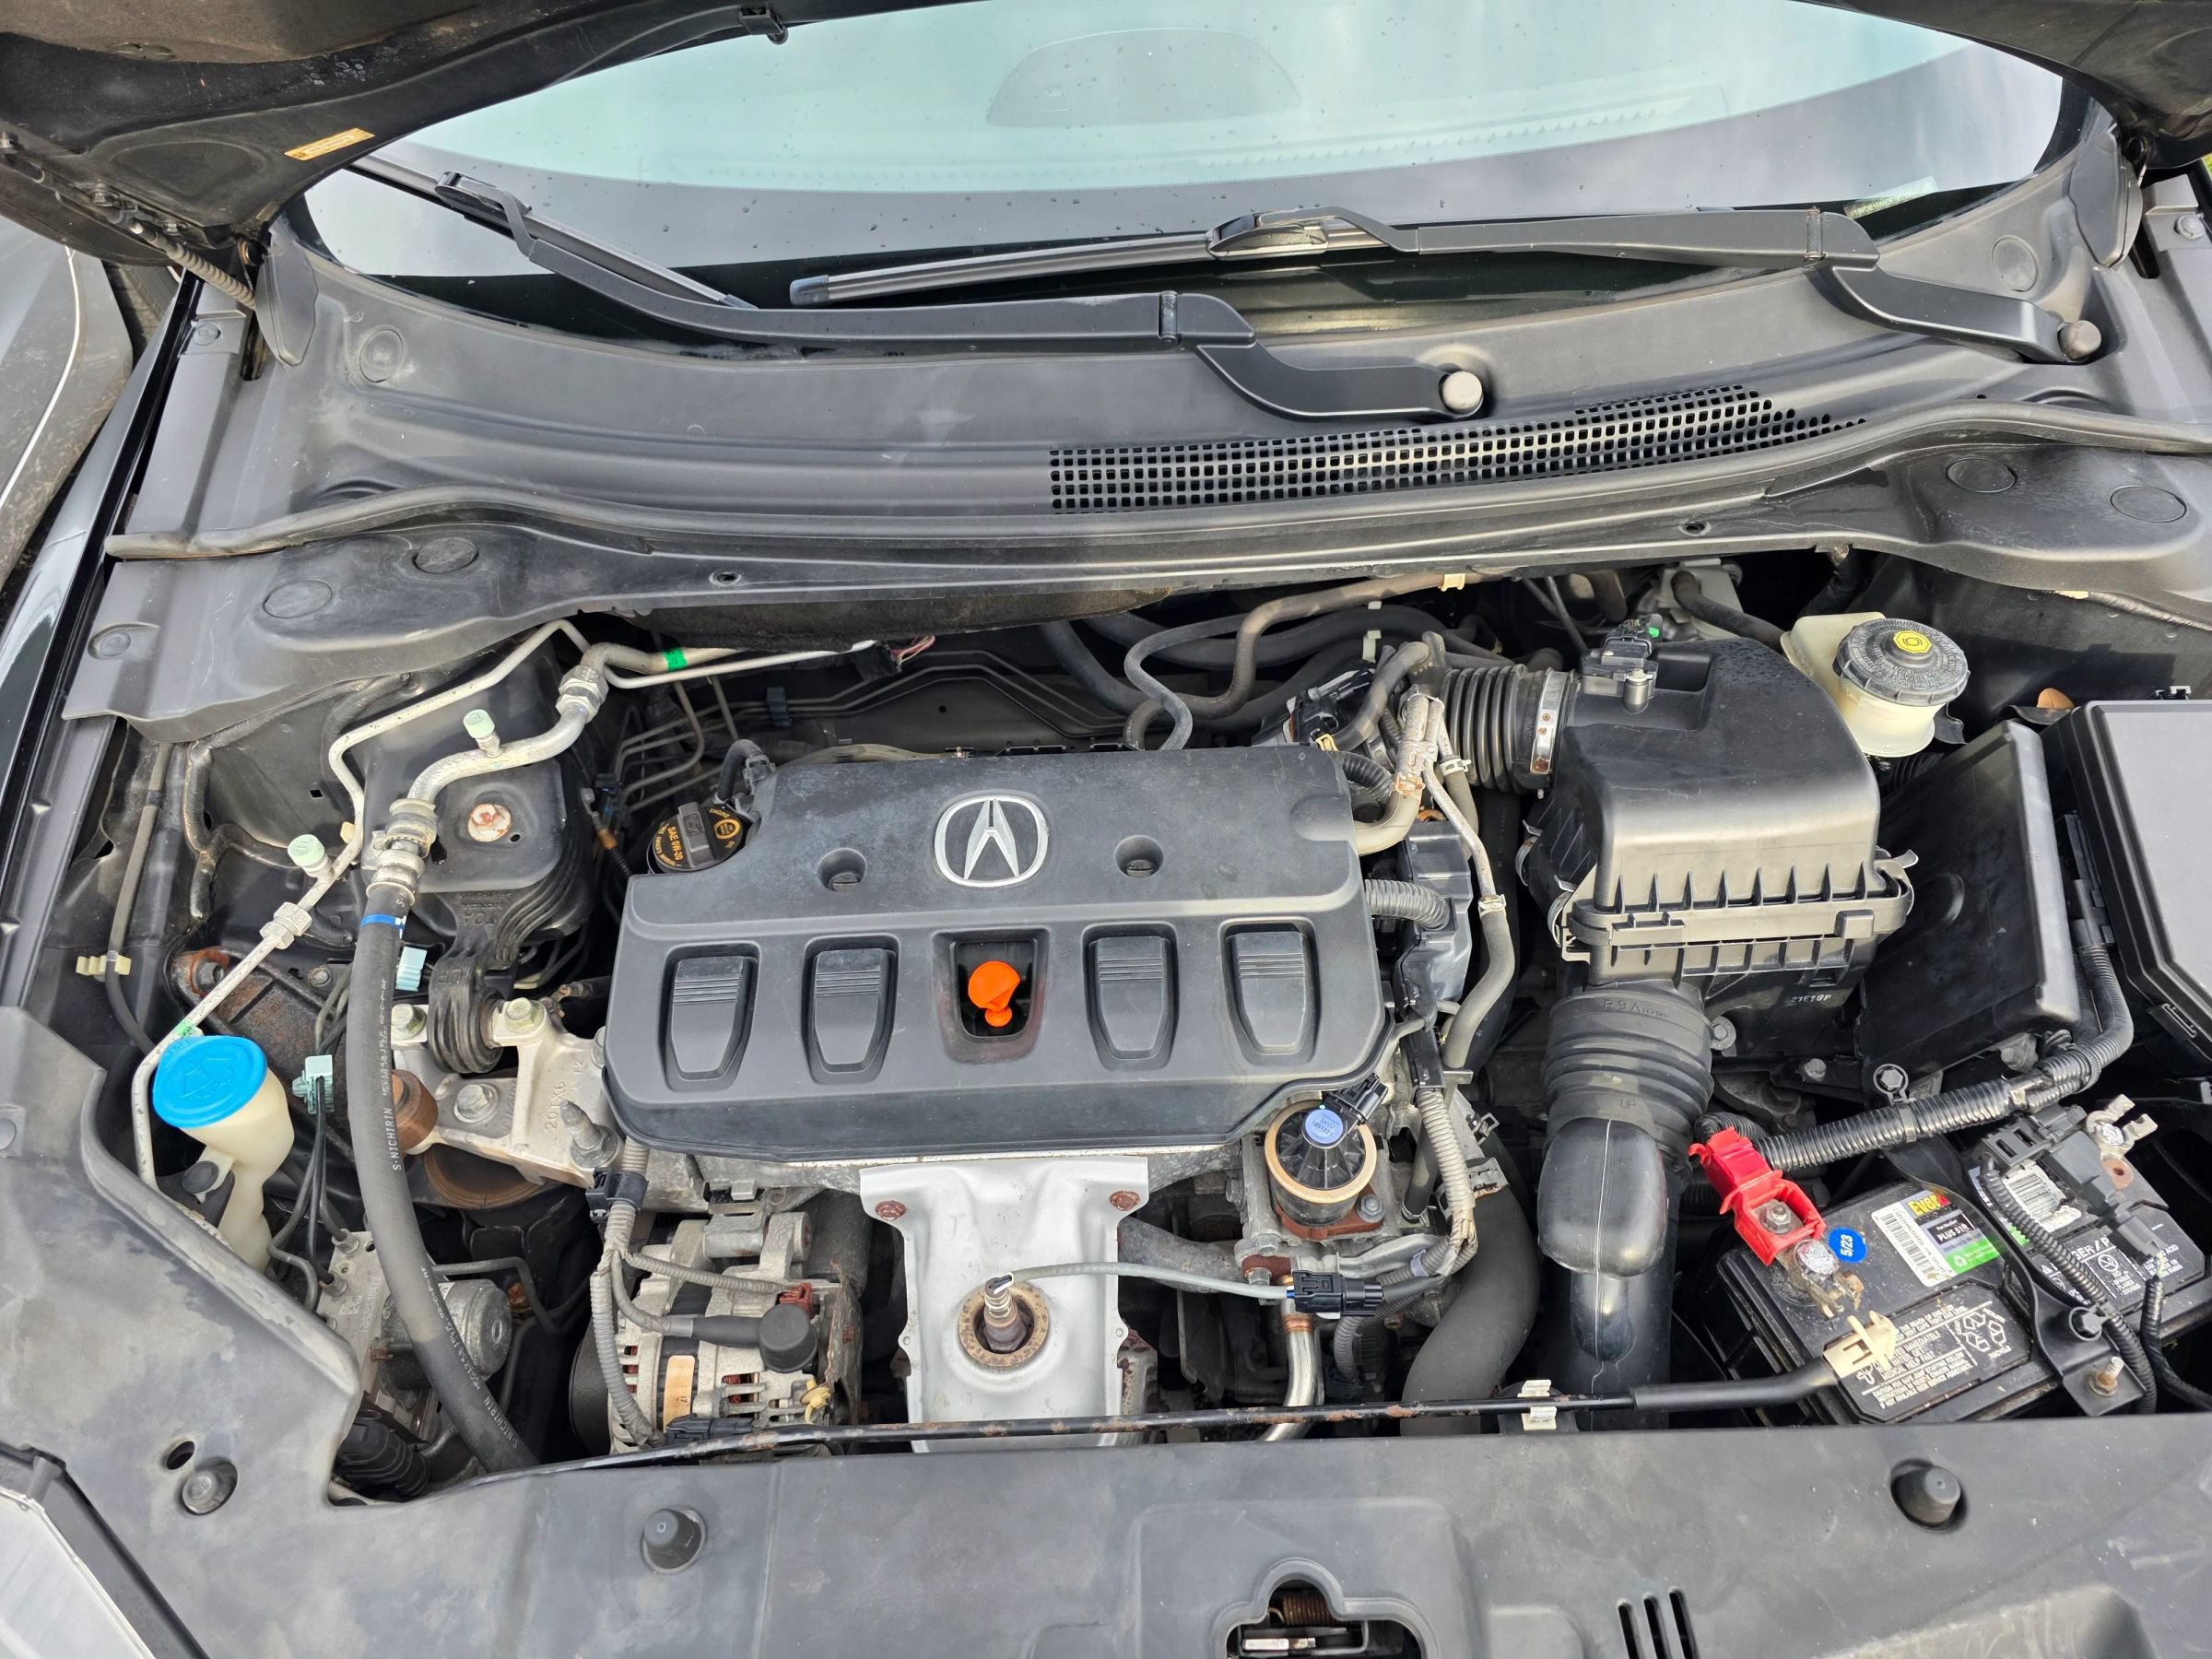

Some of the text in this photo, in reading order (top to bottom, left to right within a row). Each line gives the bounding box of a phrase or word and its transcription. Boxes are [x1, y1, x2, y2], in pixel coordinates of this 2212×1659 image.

[667, 826, 684, 861] SAE 0W-20
[1619, 1098, 1637, 1111] UP
[1937, 1223, 1970, 1241] PLUS 51R
[1841, 1234, 1853, 1257] 5/23
[1904, 1357, 1921, 1370] HELP
[1919, 1351, 1936, 1362] FAST
